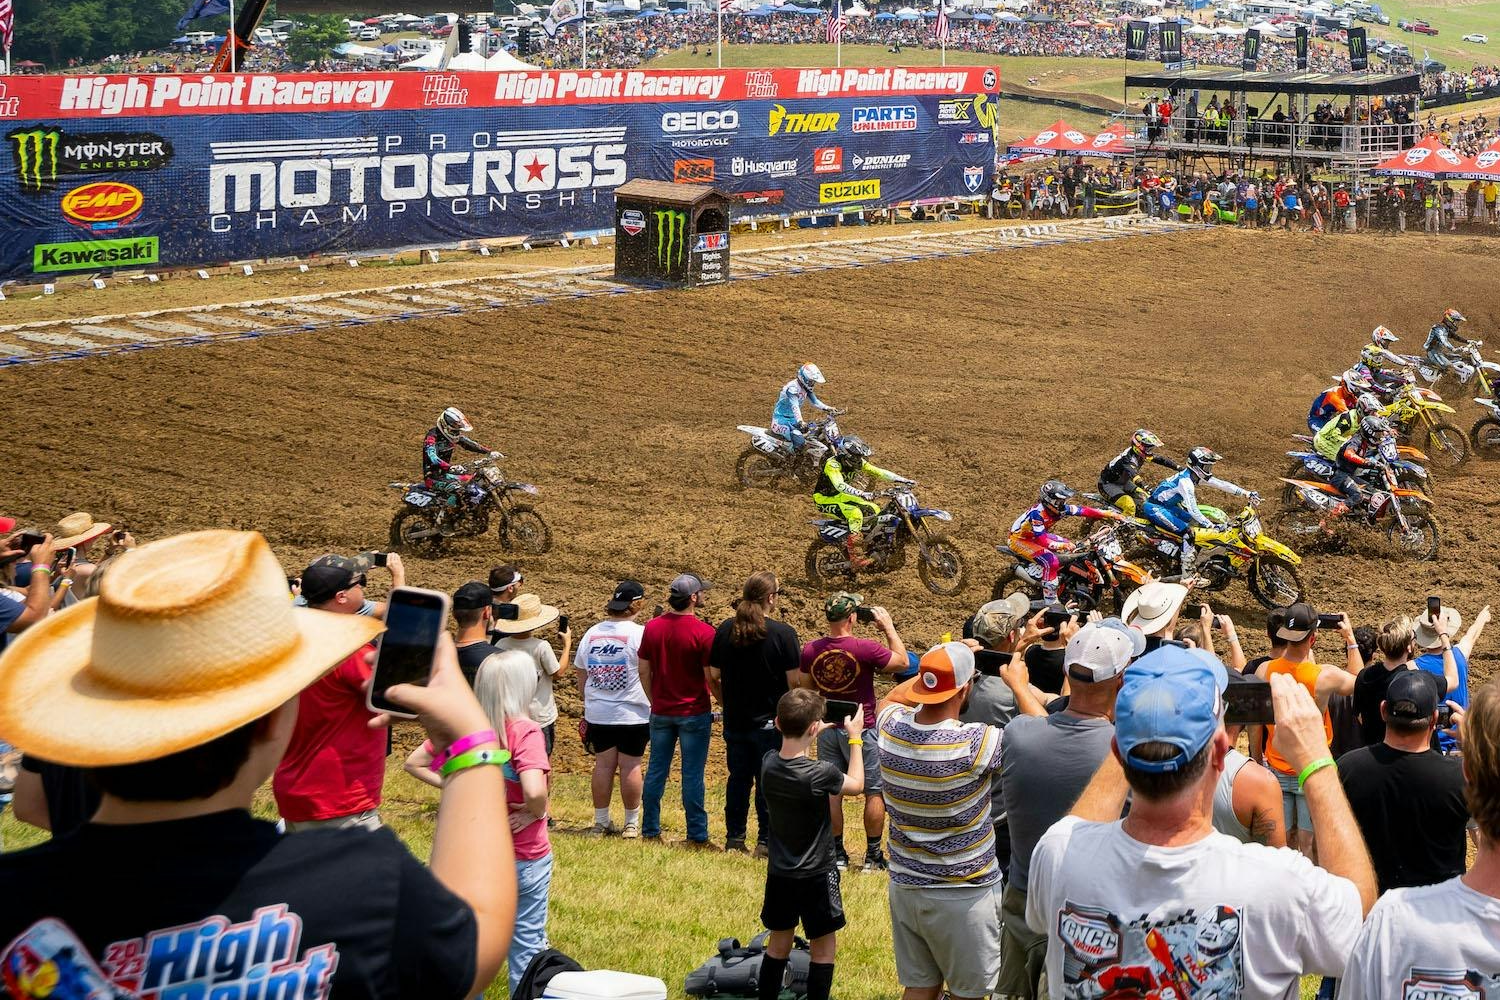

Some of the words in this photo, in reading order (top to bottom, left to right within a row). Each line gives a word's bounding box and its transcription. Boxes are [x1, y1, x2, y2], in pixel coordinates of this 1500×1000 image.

[423, 75, 461, 92] High
[746, 71, 773, 86] High
[797, 69, 842, 96] High
[842, 68, 891, 92] Point
[891, 68, 969, 93] Raceway
[60, 77, 149, 115] High
[151, 74, 246, 107] Point
[248, 76, 395, 108] Raceway
[495, 72, 556, 104] High
[556, 71, 624, 99] Point
[623, 71, 726, 99] Raceway
[746, 82, 779, 98] Point
[424, 89, 468, 106] Point
[661, 110, 739, 132] GEICO
[785, 112, 841, 133] THOR
[853, 106, 916, 122] PARTS
[853, 120, 916, 132] UNLIMITED
[385, 132, 491, 152] PRO
[672, 137, 729, 148] MOTORCYCLE
[64, 141, 166, 161] MONSTER
[863, 154, 912, 165] DUNLOP
[80, 159, 151, 170] ENERGY
[744, 159, 797, 174] Husqvarna
[209, 144, 628, 214] MOTOCROSS
[1374, 169, 1435, 179] PROMOTOCROSS
[823, 184, 876, 199] SUZUKI
[69, 192, 137, 209] FMF
[210, 190, 618, 233] CHAMPIONSHI
[41, 242, 152, 266] Kawasaki
[771, 423, 788, 435] FXR
[590, 644, 624, 655] FMF
[1062, 917, 1117, 950] GNCC
[142, 907, 296, 991] High
